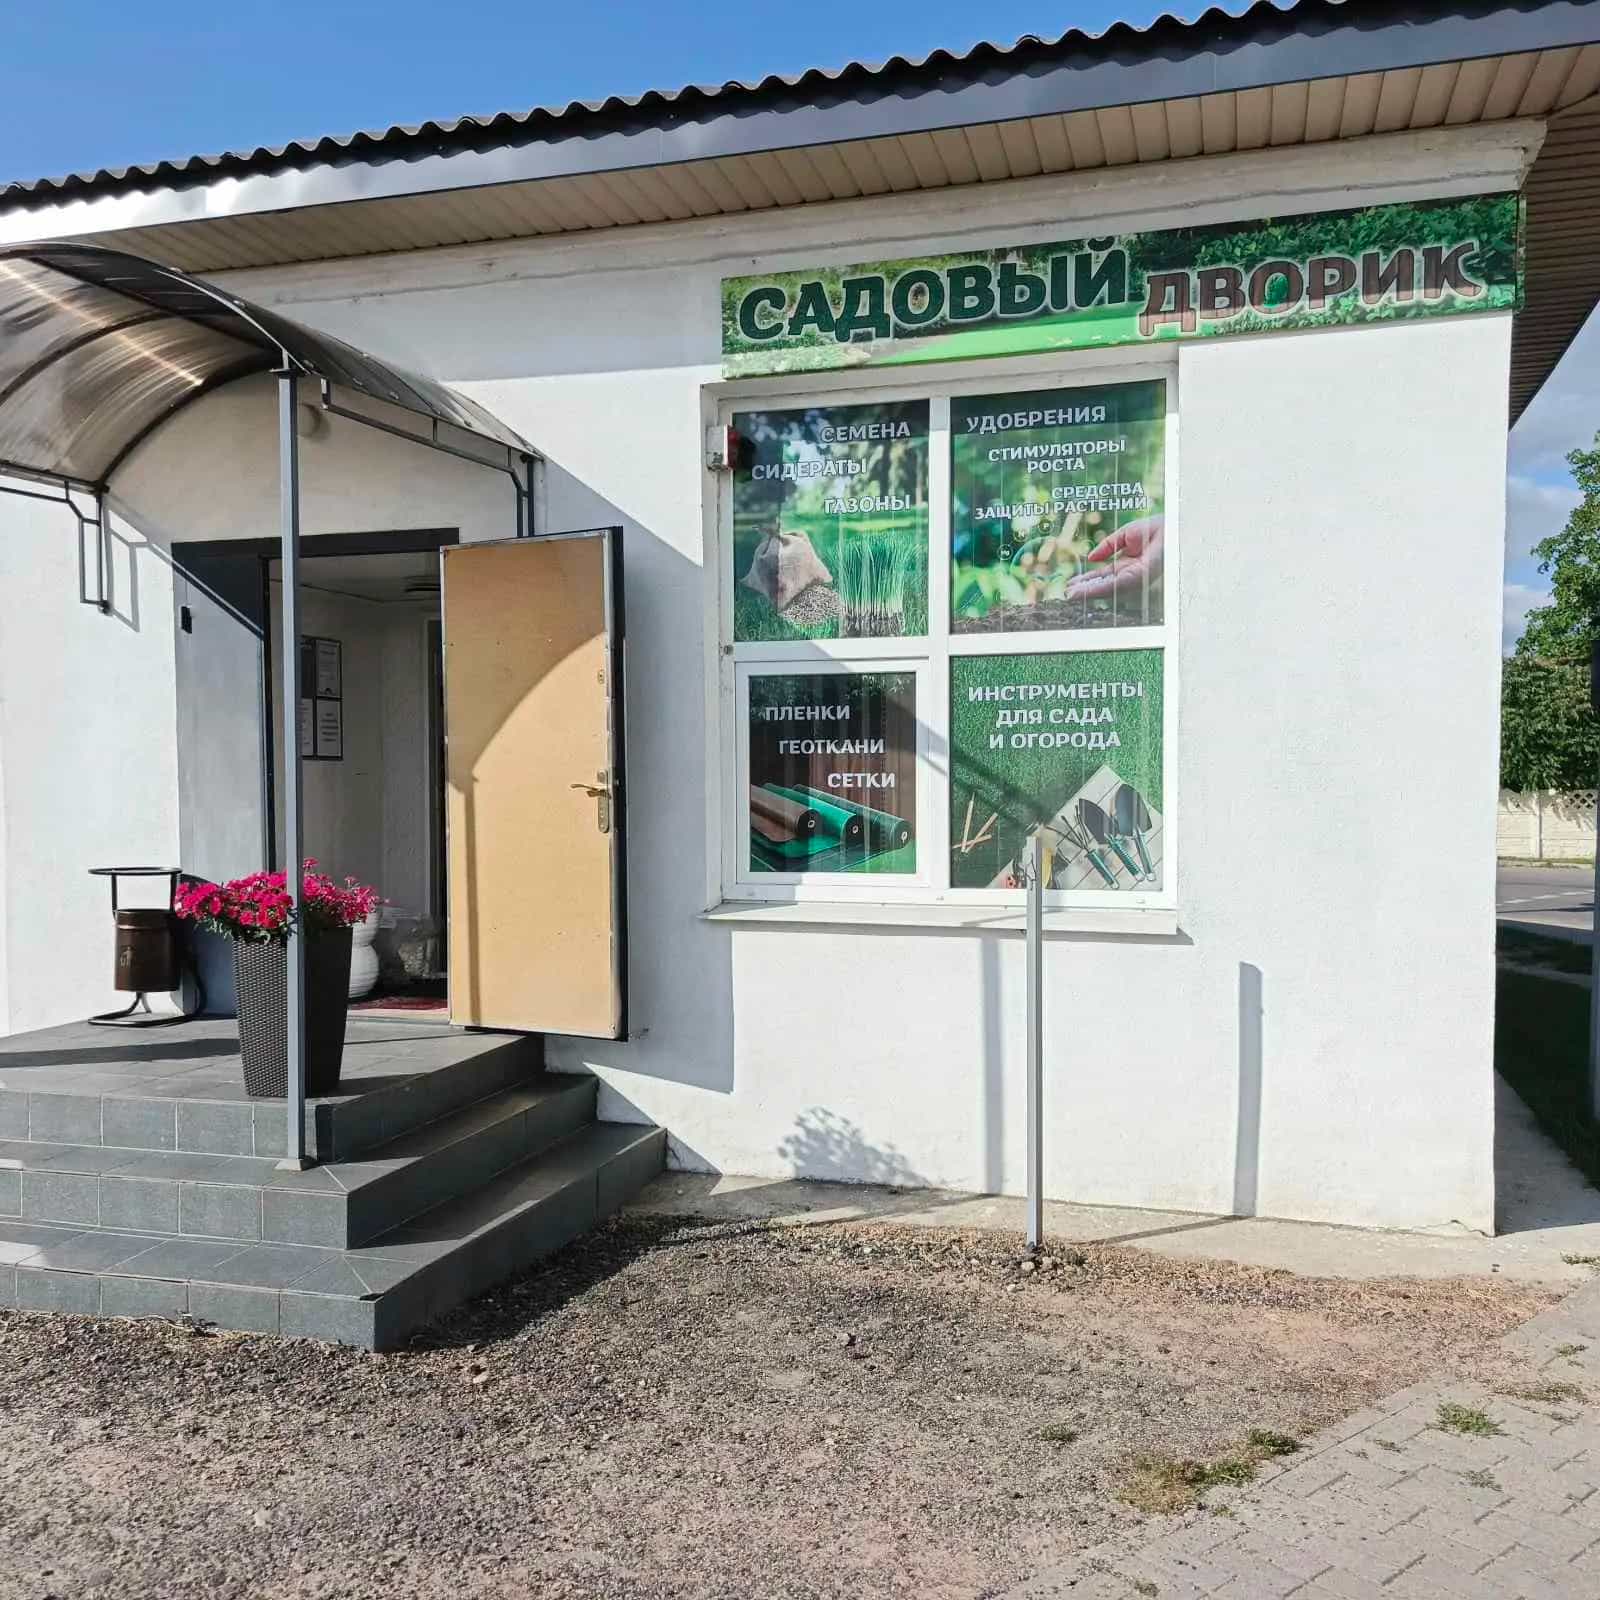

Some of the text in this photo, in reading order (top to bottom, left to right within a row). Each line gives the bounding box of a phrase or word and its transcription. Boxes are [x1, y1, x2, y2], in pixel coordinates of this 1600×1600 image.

[737, 237, 1485, 342] САДОВЫЙ ДВОРИК
[966, 405, 1106, 434] УДОБРЕНИЯ
[821, 421, 911, 443] СЕМЕНА
[988, 439, 1126, 462] СТИМУЛЯТОРЫ
[751, 458, 867, 481] СИДЕРАТЫ
[1027, 457, 1085, 474] РОСТА
[1051, 481, 1144, 500] СРЕДСТВА
[823, 494, 911, 514] ГАЗОНЫ
[974, 494, 1147, 520] ЗАЩИТЫ РАСТЕНИЙ
[968, 682, 1143, 701] ИНСТРУМЕНТЫ
[764, 705, 851, 721] ПЛЕНКИ
[996, 707, 1114, 728] ДЛЯ САДА
[779, 739, 885, 755] ГЕОТКАНИ
[989, 731, 1121, 751] И ОГОРОДА
[827, 773, 895, 788] СЕТКИ
